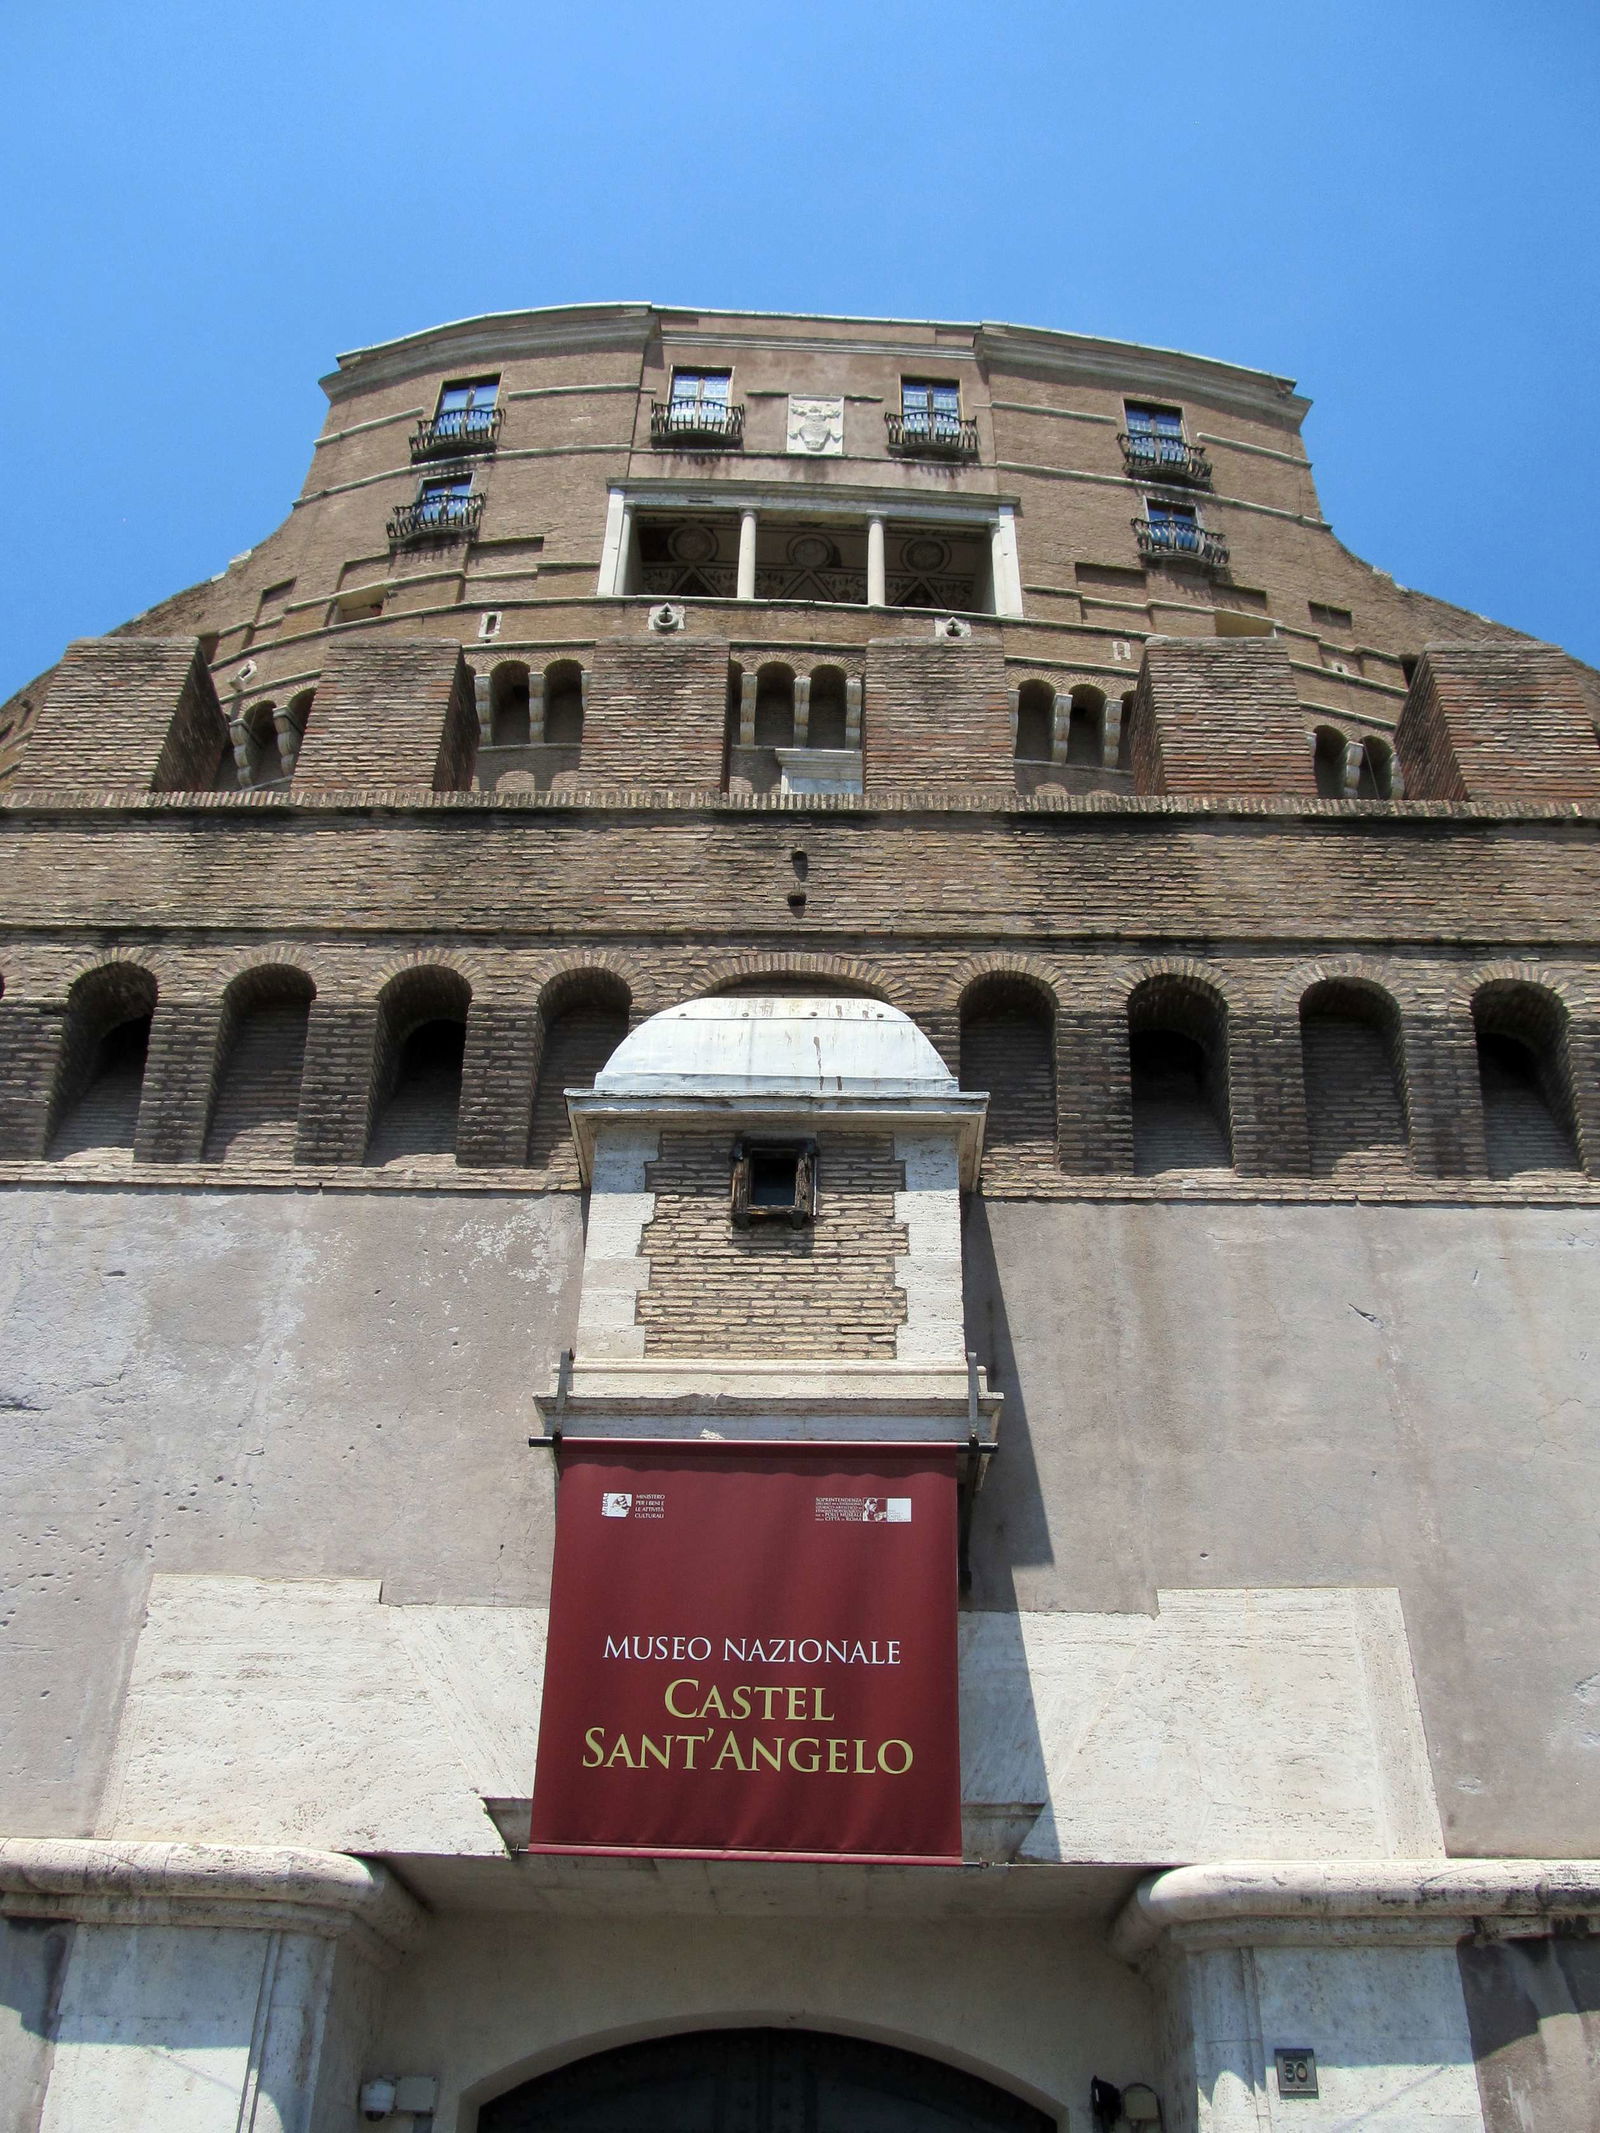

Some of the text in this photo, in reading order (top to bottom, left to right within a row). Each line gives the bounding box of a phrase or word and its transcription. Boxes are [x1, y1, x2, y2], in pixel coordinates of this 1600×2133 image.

[602, 1634, 901, 1665] MUSEO NAZIONALE
[664, 1678, 835, 1721] CASTEL
[582, 1727, 914, 1775] SANT'ANGELO
